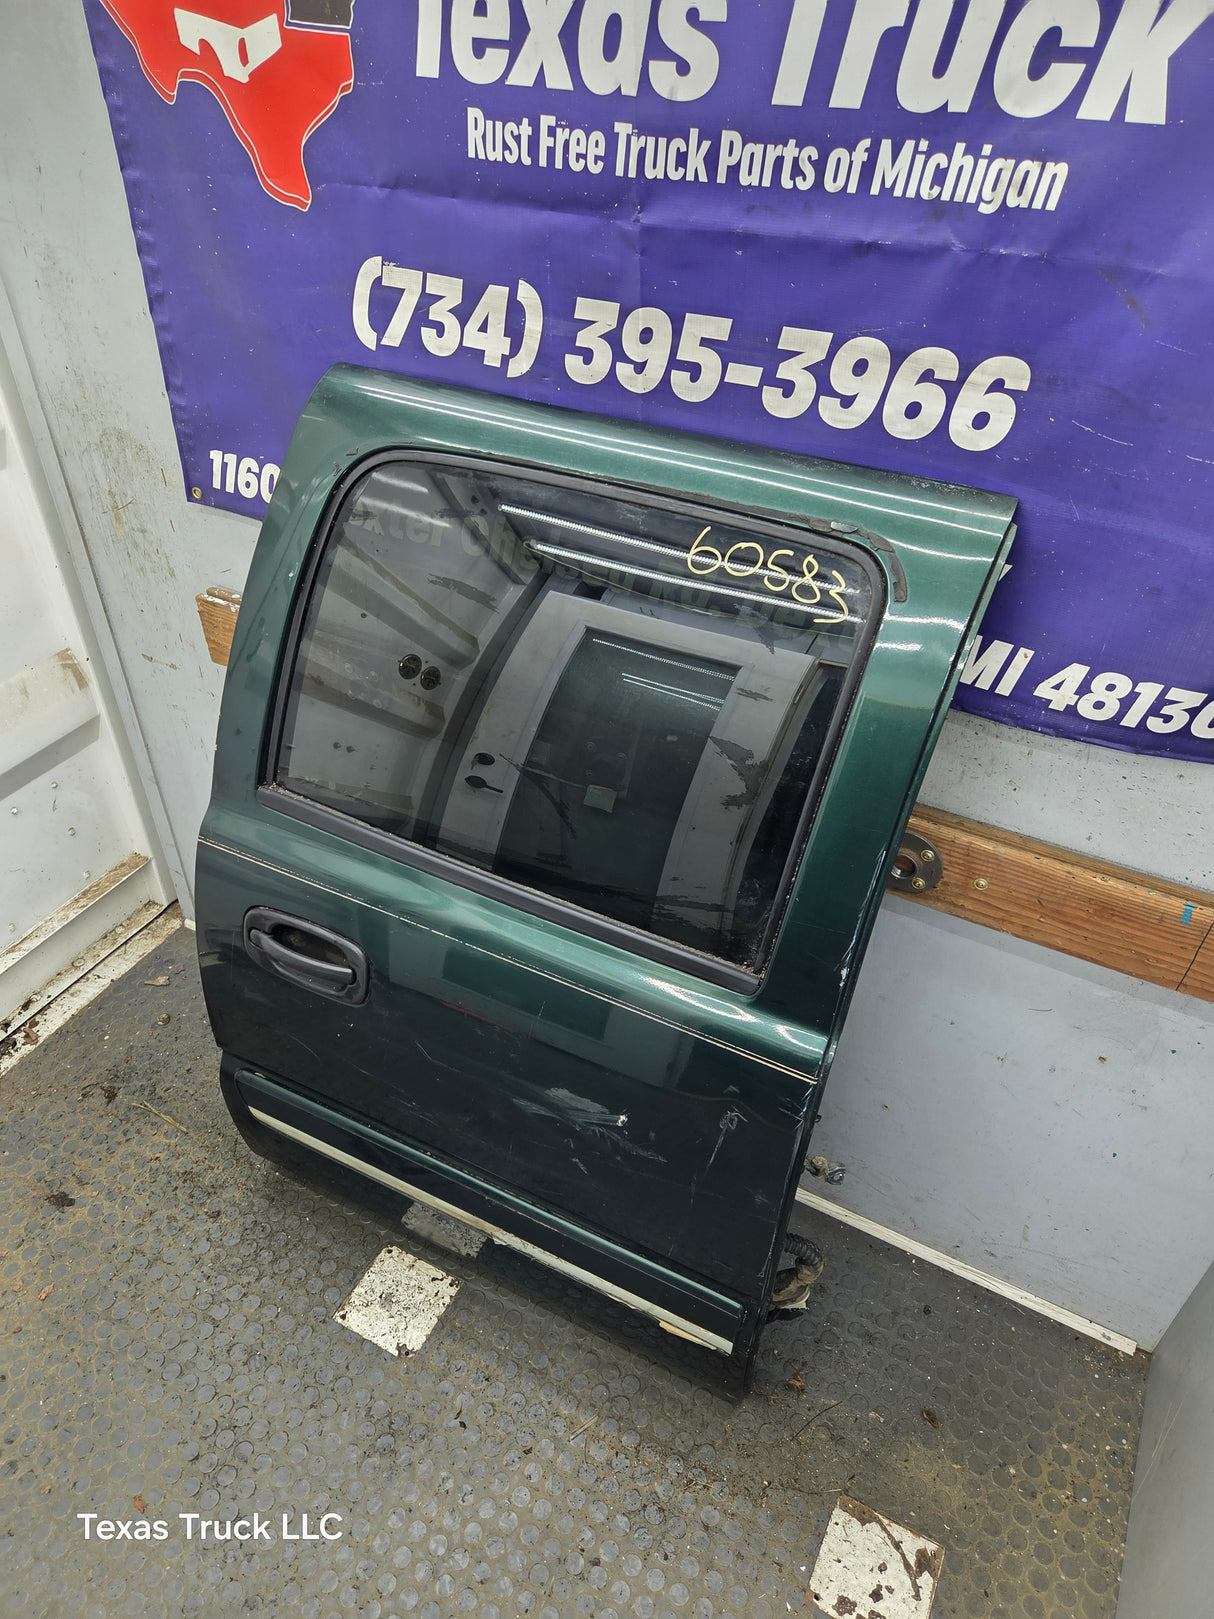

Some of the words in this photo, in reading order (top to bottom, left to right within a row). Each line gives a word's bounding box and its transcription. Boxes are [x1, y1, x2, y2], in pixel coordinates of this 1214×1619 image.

[467, 107, 532, 166] Rust
[539, 115, 605, 175] Free
[614, 122, 711, 183] Truck
[717, 130, 818, 191] Parts
[824, 138, 871, 194] of
[870, 138, 1069, 214] Michigan
[352, 255, 543, 378] (734)
[564, 297, 1032, 452] 395-3966
[687, 525, 849, 623] 60583
[959, 634, 1035, 697] MI
